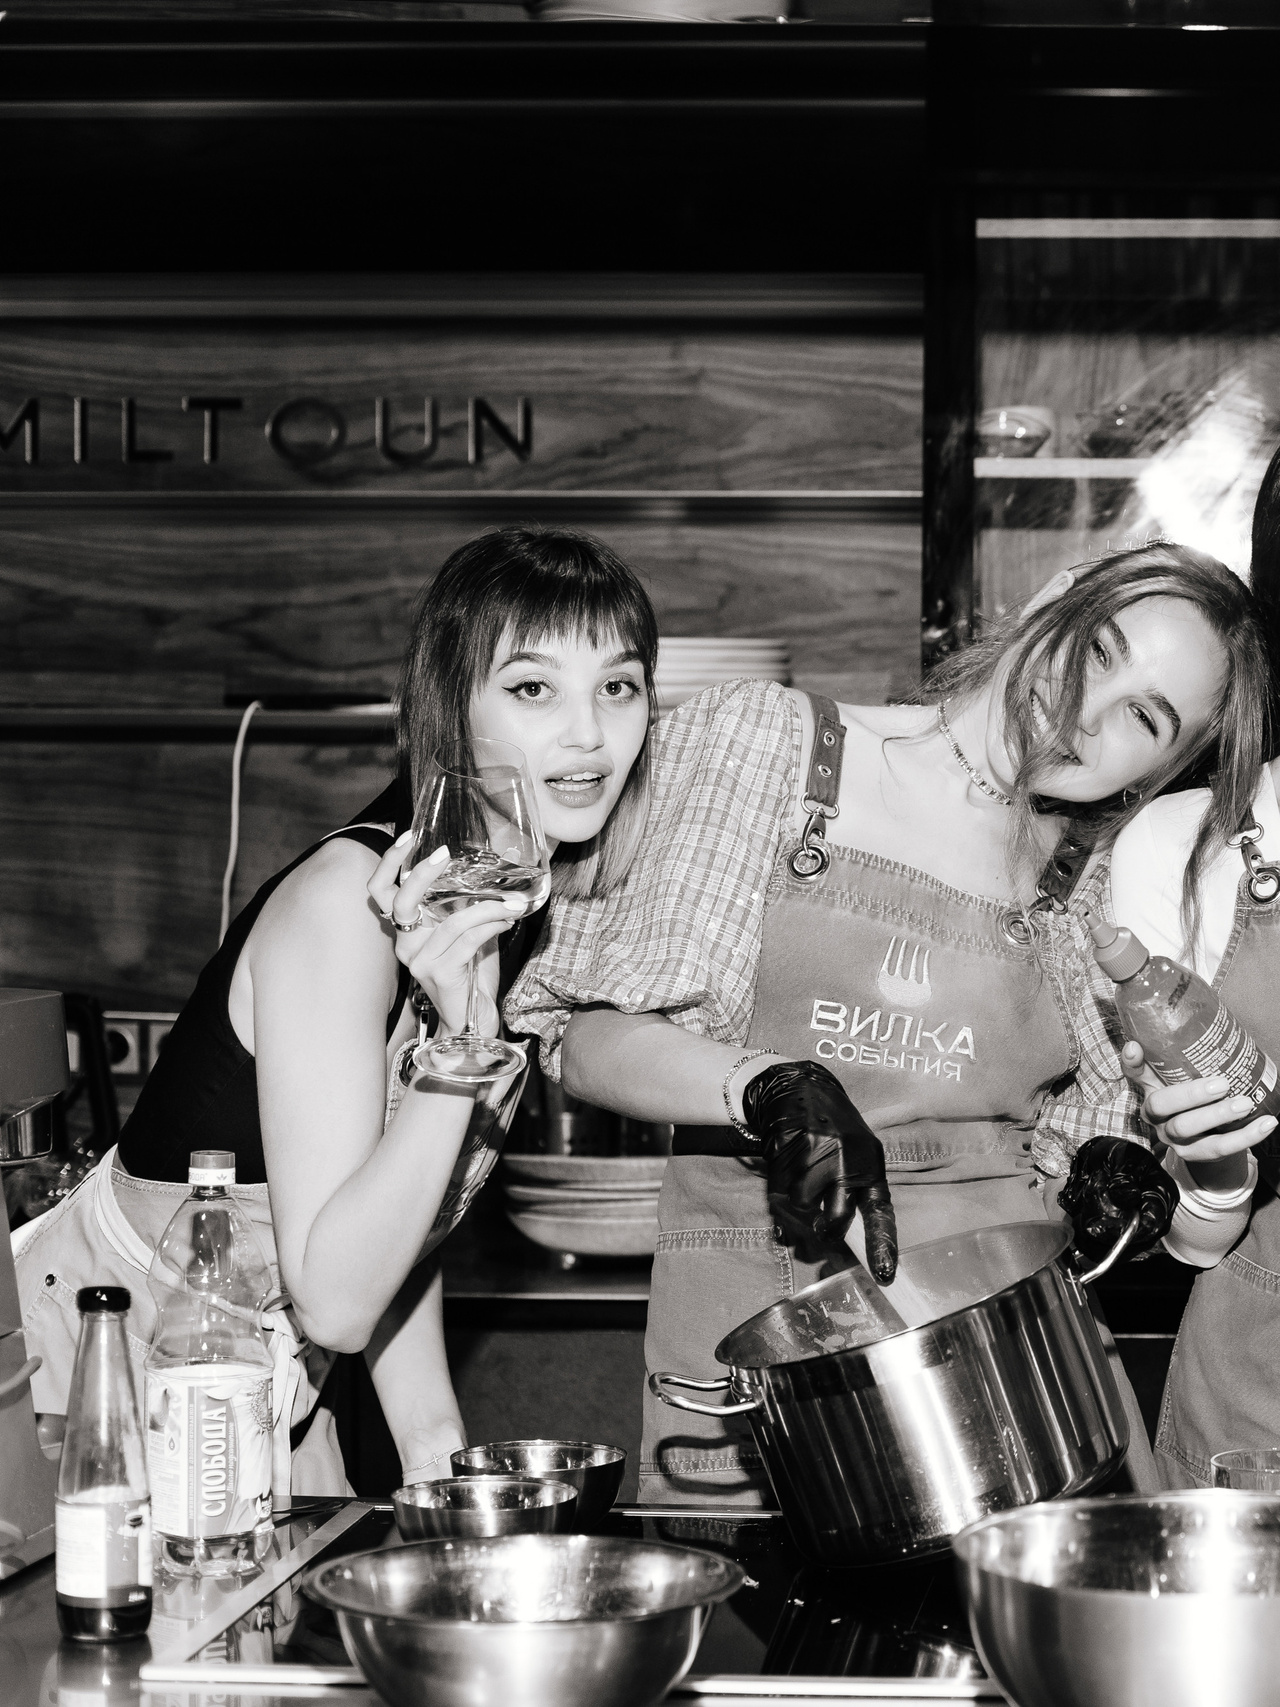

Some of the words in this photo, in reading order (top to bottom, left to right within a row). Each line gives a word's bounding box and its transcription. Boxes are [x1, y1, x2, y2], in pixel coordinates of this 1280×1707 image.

[810, 999, 977, 1062] ВИЛКА
[815, 1038, 963, 1082] СОБЫТИЯ
[201, 1406, 227, 1517] СЛОБОДА
